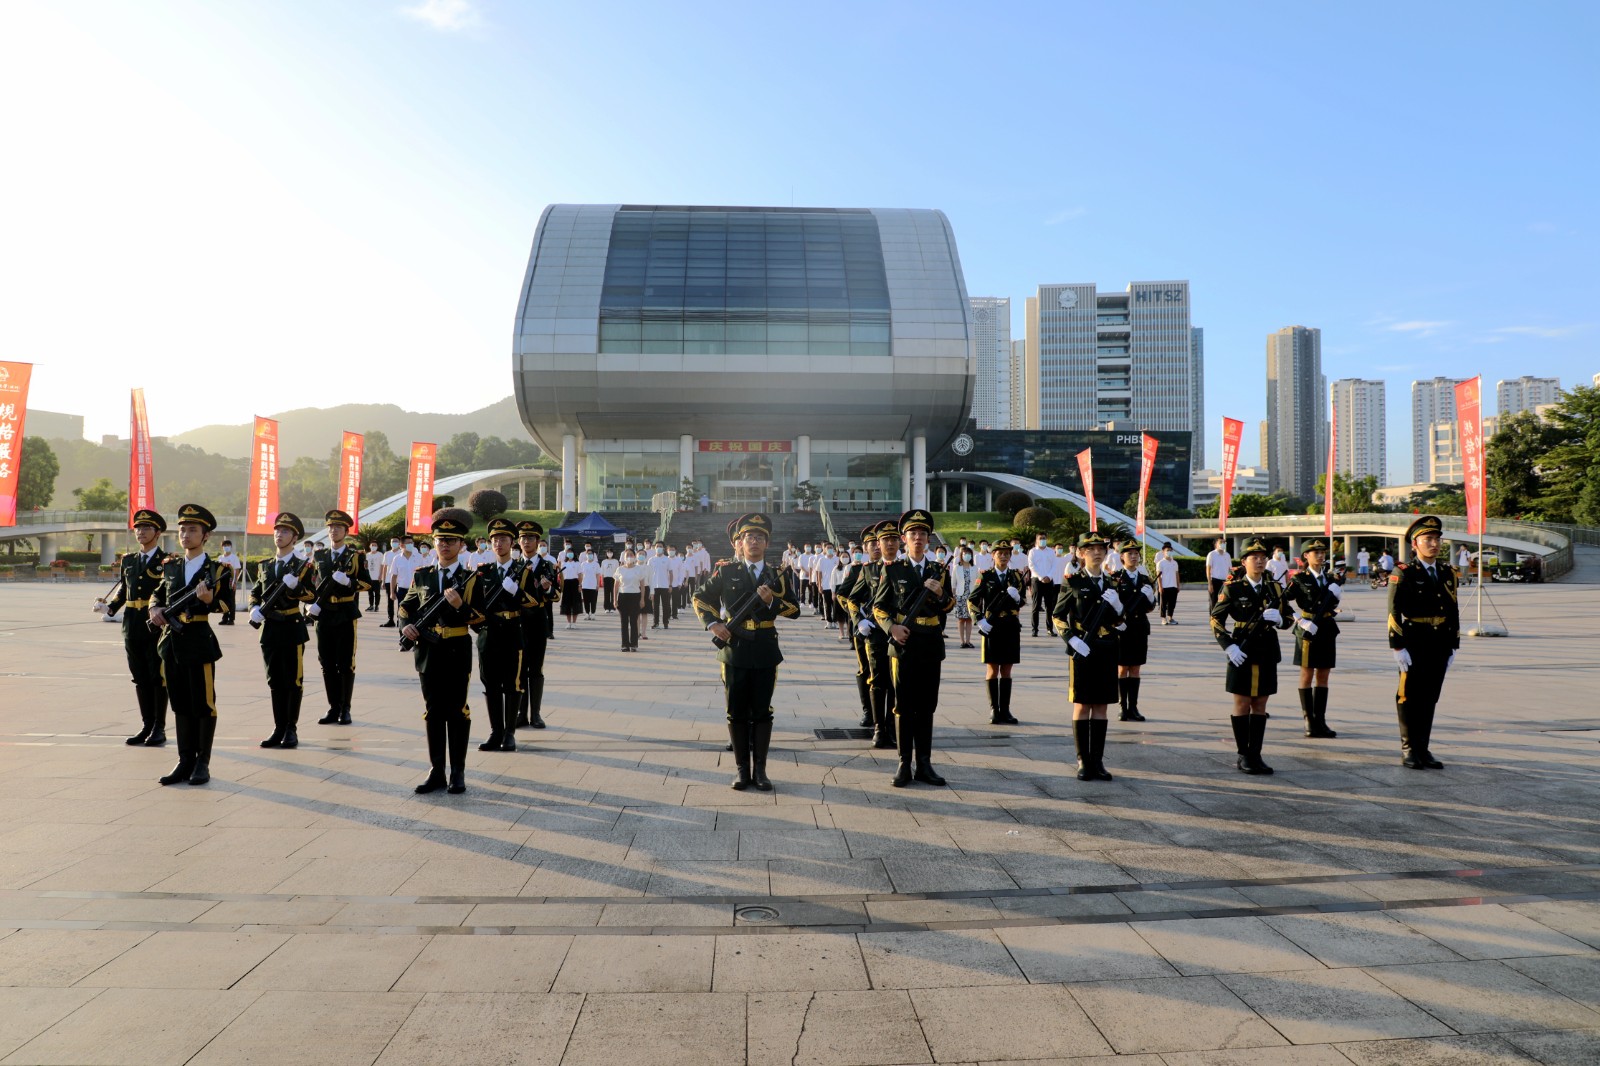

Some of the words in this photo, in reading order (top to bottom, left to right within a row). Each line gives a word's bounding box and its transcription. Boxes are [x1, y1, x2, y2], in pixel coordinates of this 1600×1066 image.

[1136, 289, 1183, 303] HITSZ
[708, 441, 783, 451] 庆祝国庆
